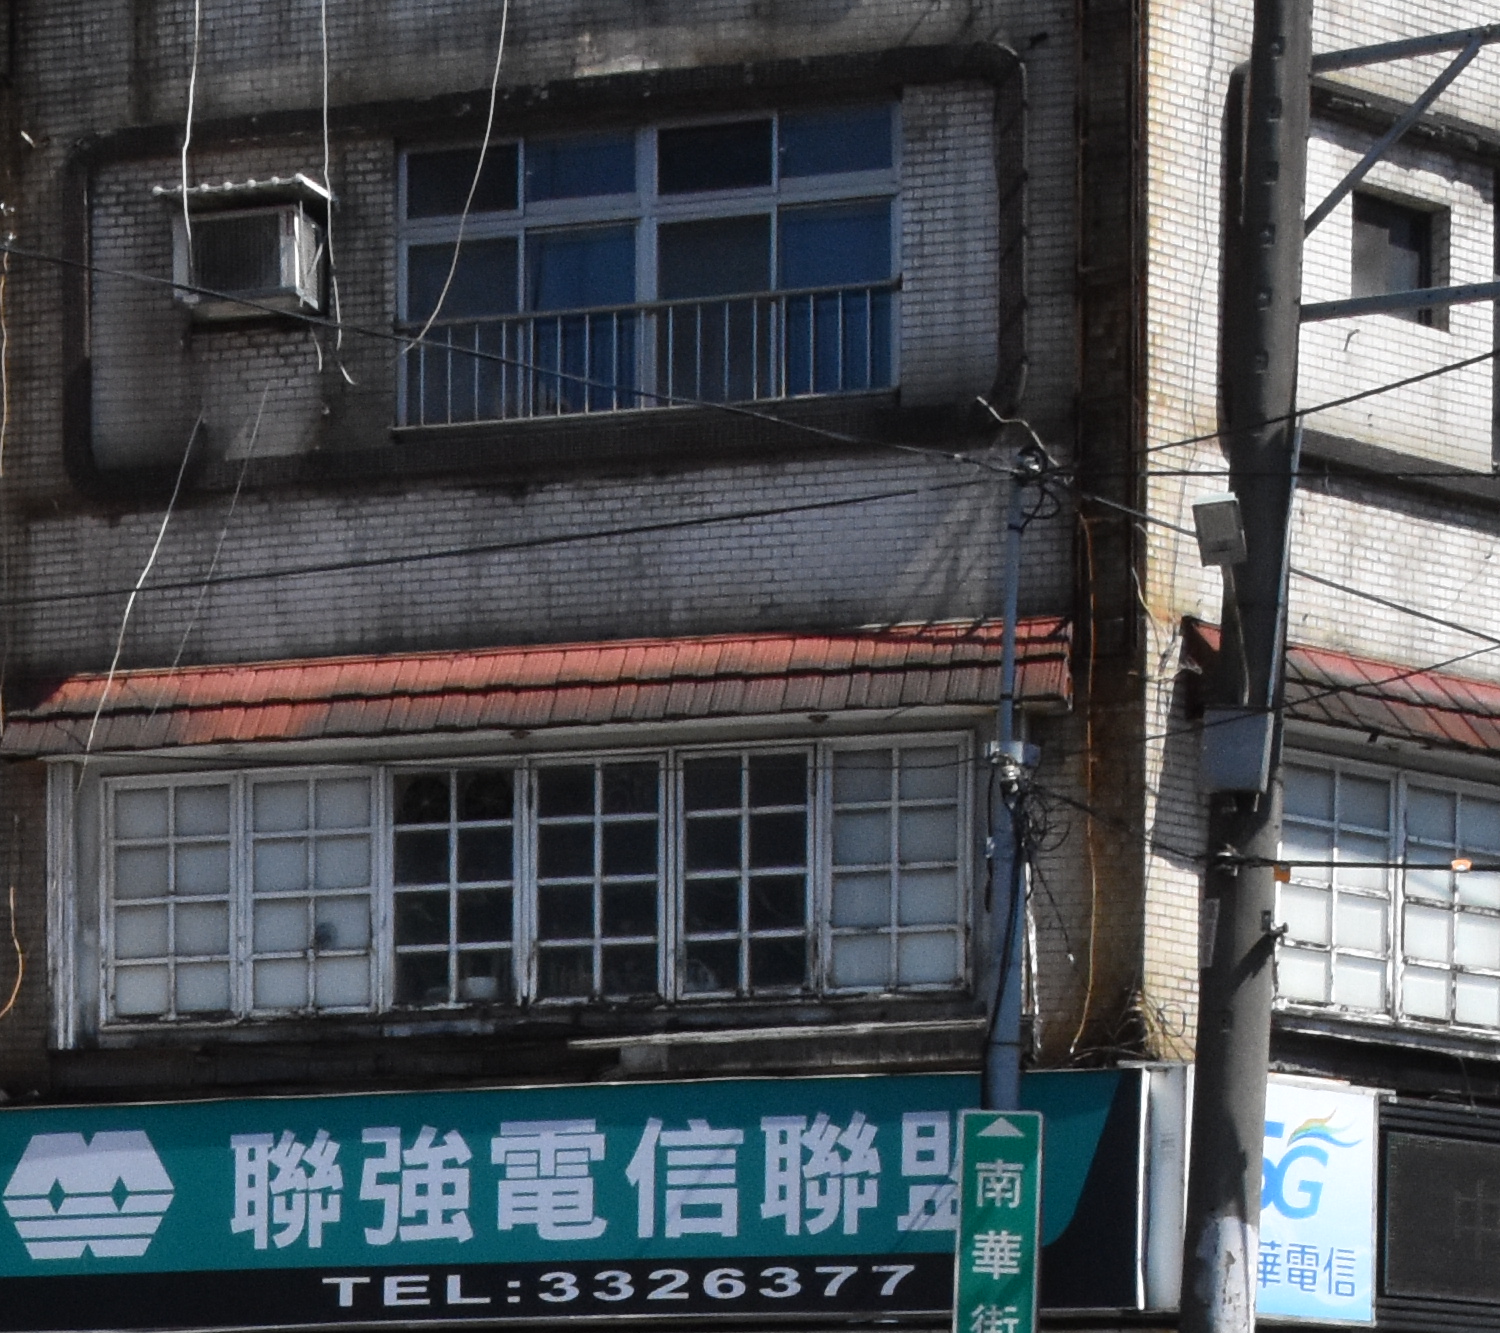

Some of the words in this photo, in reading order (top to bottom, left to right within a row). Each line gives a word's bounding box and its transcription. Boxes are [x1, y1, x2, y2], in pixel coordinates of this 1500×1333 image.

[230, 1111, 960, 1250] 聯強電信聯盟
